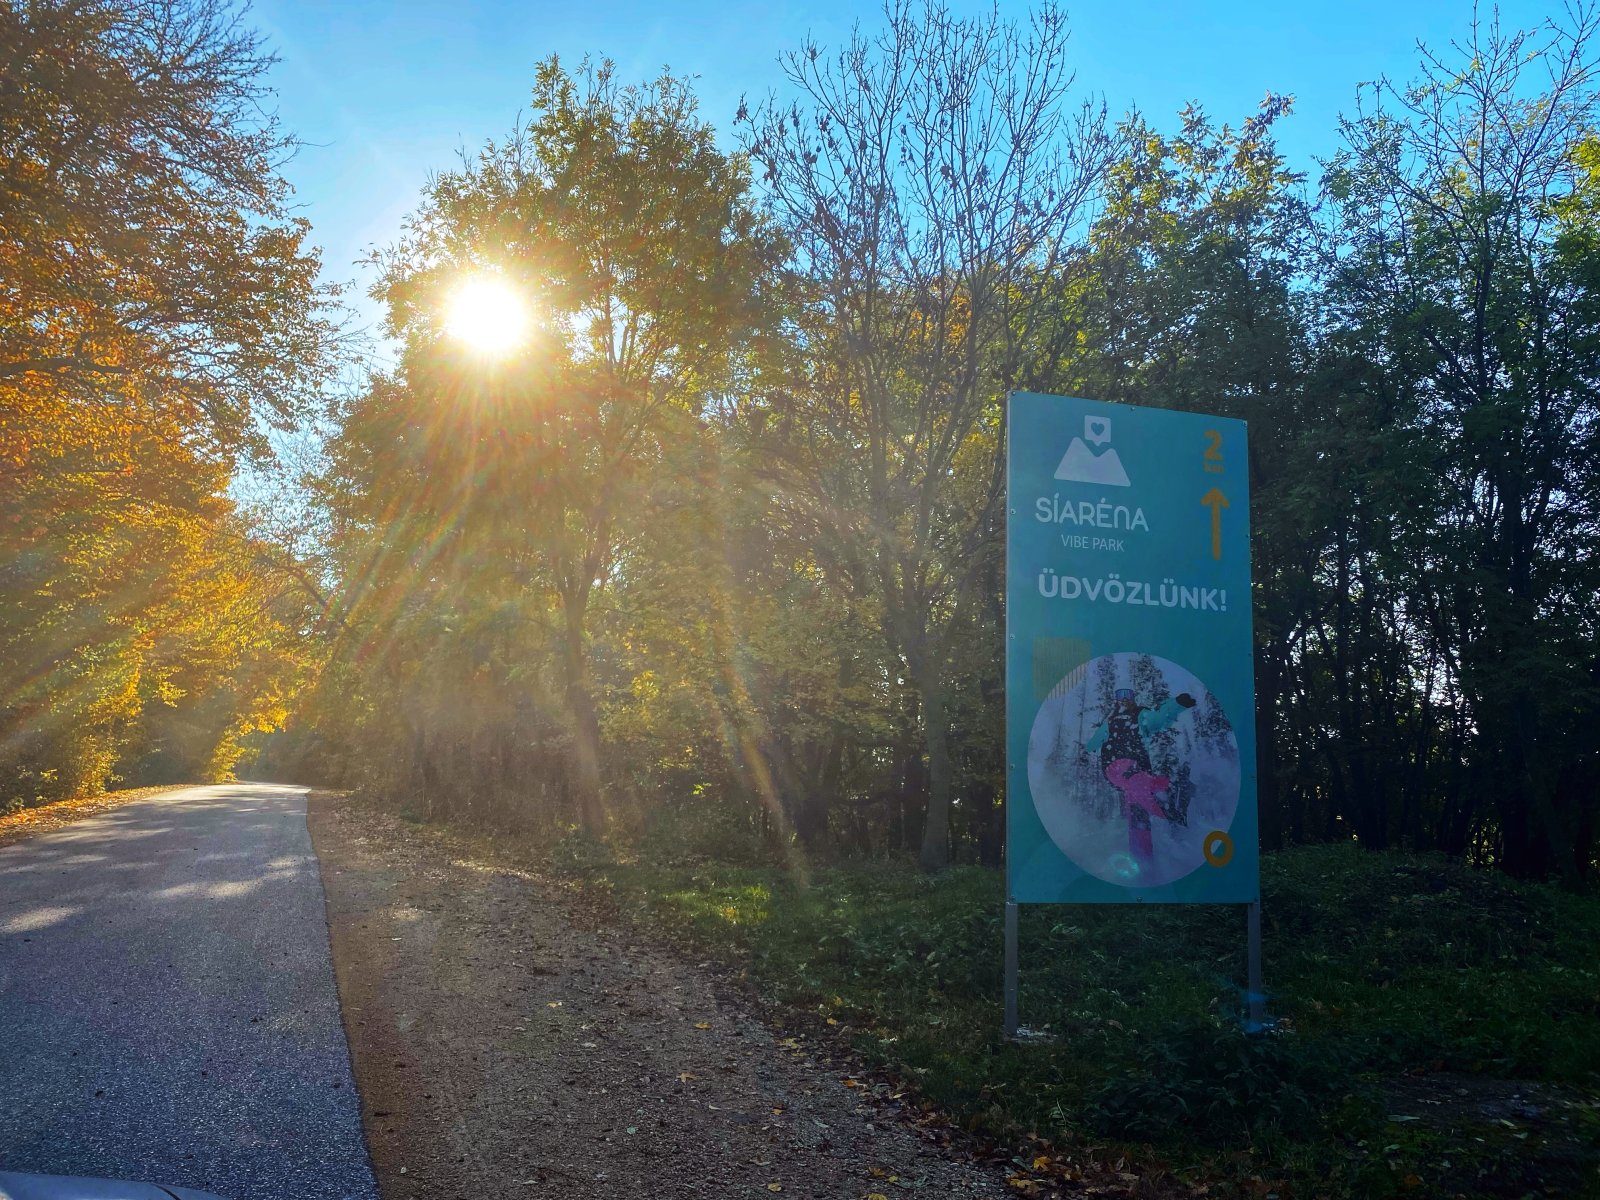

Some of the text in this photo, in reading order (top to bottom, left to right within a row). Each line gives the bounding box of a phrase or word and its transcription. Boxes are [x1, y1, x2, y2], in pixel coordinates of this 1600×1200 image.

[1204, 429, 1223, 461] 2
[1061, 534, 1125, 552] VIBE PARK
[1038, 568, 1227, 612] ÜDVÖZLÜNK!
